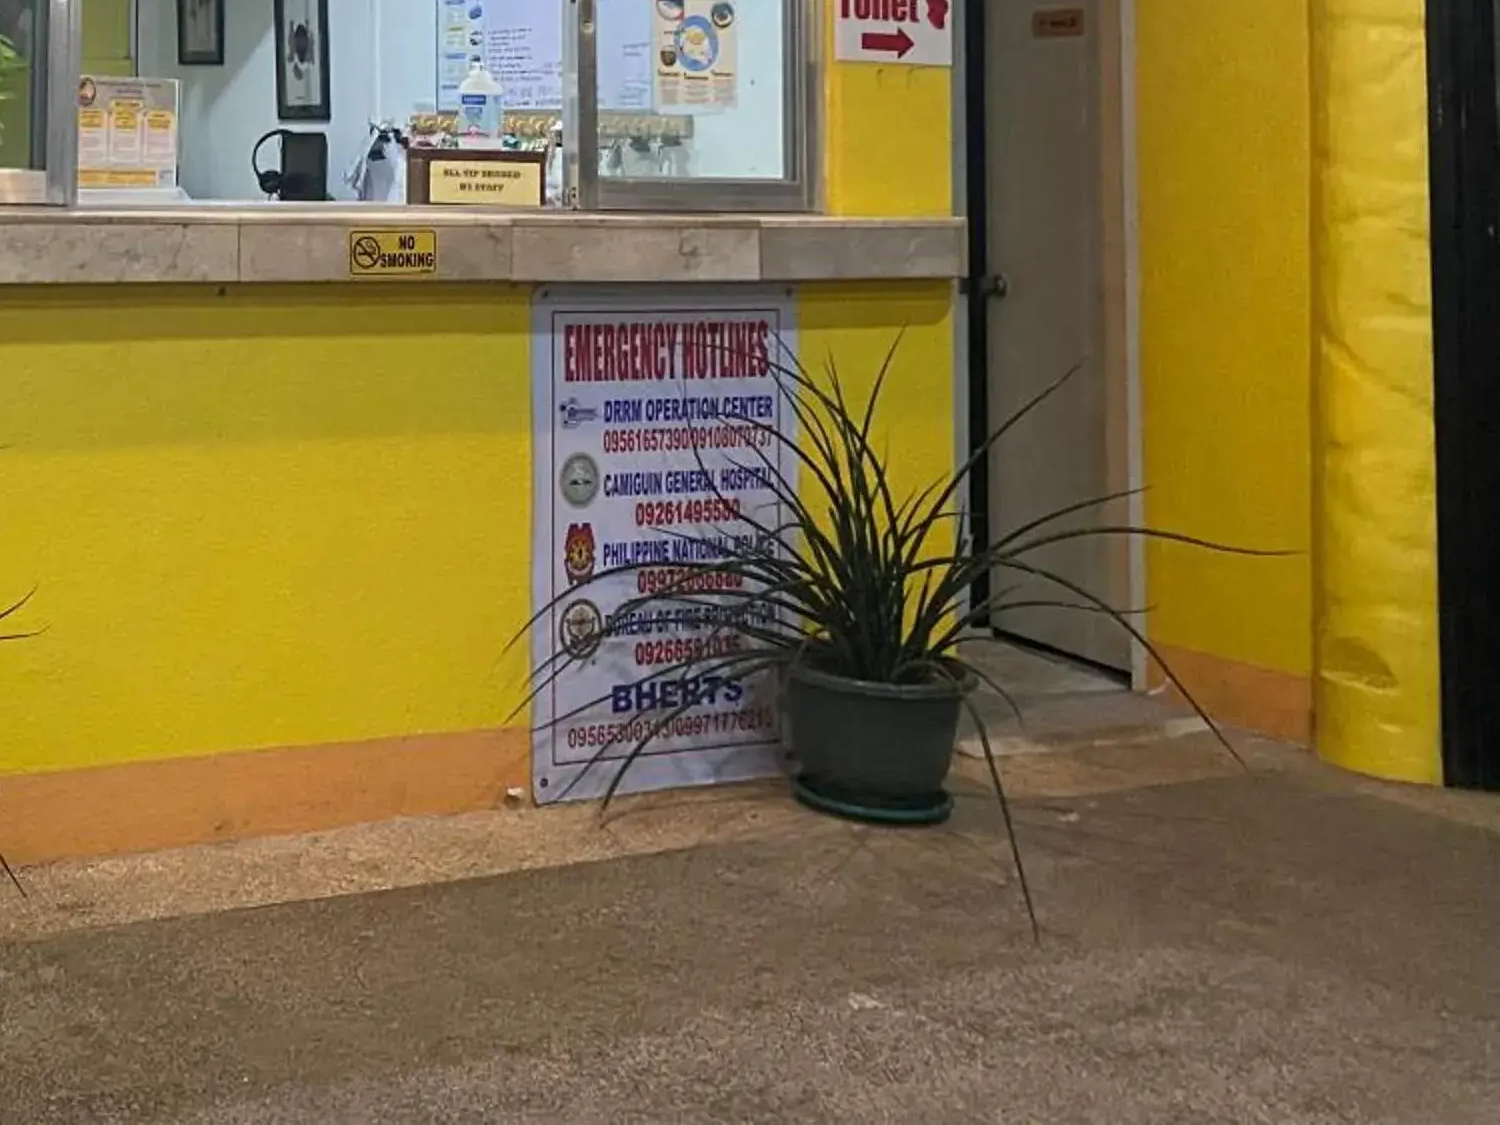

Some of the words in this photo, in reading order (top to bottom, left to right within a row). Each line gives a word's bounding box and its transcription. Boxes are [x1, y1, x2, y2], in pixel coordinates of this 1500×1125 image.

[398, 235, 415, 250] NO
[380, 252, 434, 268] SMOKING
[563, 321, 678, 382] EMERGENCY
[683, 320, 770, 379] HOTLINES
[603, 400, 643, 423] DRRM
[645, 396, 719, 422] OPERATION
[723, 395, 773, 419] CENTER
[603, 471, 663, 497] CAMIGUIN
[665, 469, 715, 494] GENERAL
[721, 466, 772, 491] HOSPITAL
[603, 540, 669, 567] PHILIPPINE
[672, 536, 729, 561] NATIONAL
[611, 676, 743, 714] BHERTS
